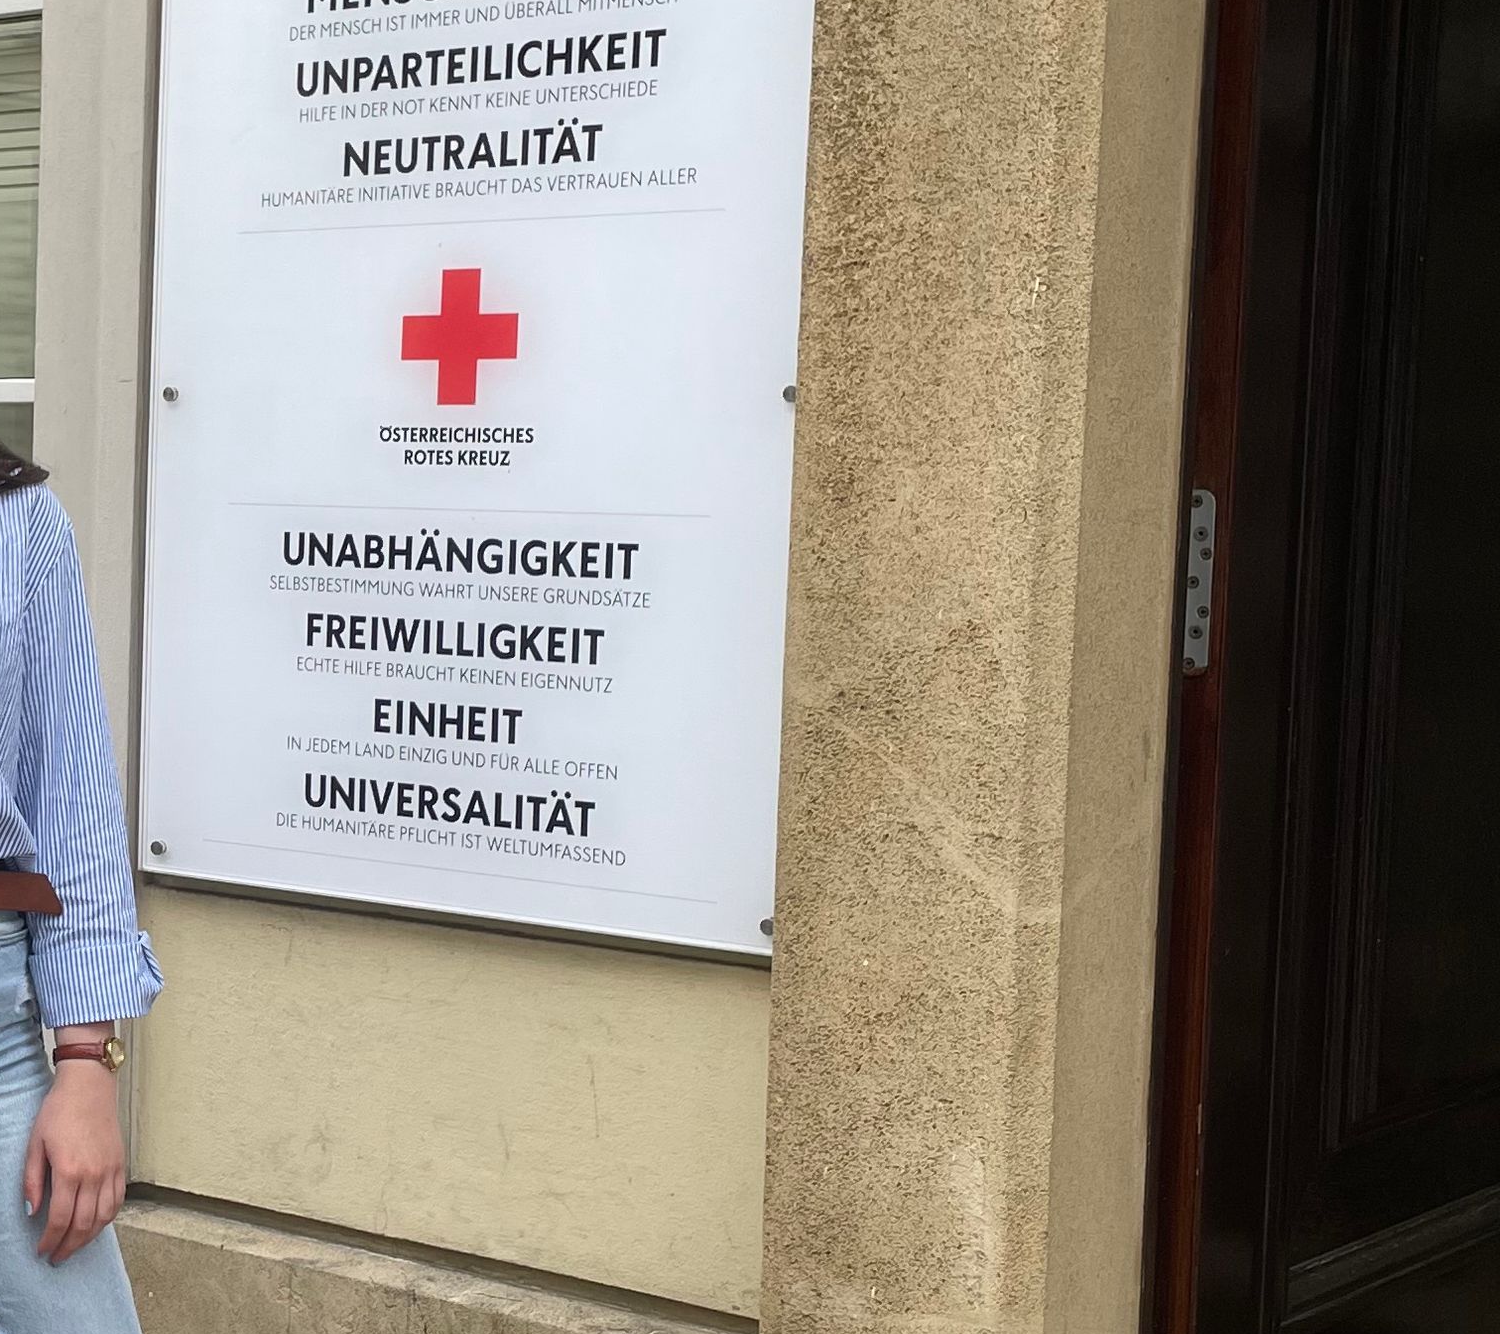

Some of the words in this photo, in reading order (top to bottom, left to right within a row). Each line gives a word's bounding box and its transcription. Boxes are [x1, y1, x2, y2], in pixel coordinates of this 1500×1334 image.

[289, 24, 317, 42] DER
[319, 17, 382, 39] MENSCH
[385, 11, 408, 33] IST
[410, 8, 461, 30] IMMER
[464, 5, 501, 25] UND
[296, 28, 668, 98] UNPARTEILICHKEIT
[299, 104, 338, 124] HILFE
[340, 101, 357, 120] IN
[360, 98, 389, 119] DER
[392, 97, 426, 117] NOT
[428, 93, 482, 114] KENNT
[485, 89, 532, 109] KEINE
[535, 78, 659, 106] UNTERSCHIEDE
[343, 117, 604, 178] NEUTRALITÄT
[261, 186, 355, 208] HUMANITÄRE
[358, 182, 431, 203] INITIATIVE
[435, 178, 508, 199] BRAUCHT
[511, 172, 543, 195] DAS
[546, 170, 643, 192] VERTRAUEN
[646, 167, 697, 187] ALLER
[379, 425, 534, 444] ÖSTERREICHISCHES
[404, 449, 454, 466] ROTES
[457, 449, 511, 467] KREUZ
[283, 529, 640, 581] UNABHÄNGIGKEIT
[269, 574, 415, 597] SELBSTBESTIMMUNG
[418, 581, 475, 600] WAHRT
[478, 584, 540, 604] UNSERE
[542, 587, 652, 609] GRUNDSÄTZE
[306, 612, 605, 666] FREIWILLIGKEIT
[296, 655, 341, 674] ECHTE
[343, 659, 383, 677] HILFE
[385, 662, 456, 683] BRAUCHT
[459, 666, 517, 687] KEINEN
[520, 671, 613, 694] EIGENNUTZ
[373, 698, 523, 745] EINHEIT
[287, 735, 302, 751] IN
[305, 737, 351, 756] JEDEM
[354, 741, 396, 760] LAND
[398, 744, 448, 766] EINZIG
[451, 745, 487, 769] UND
[490, 752, 520, 772] FÜR
[522, 756, 561, 776] ALLE
[564, 760, 618, 781] OFFEN
[304, 772, 596, 838] UNIVERSALITÄT
[276, 811, 299, 829] DIE
[301, 814, 396, 841] HUMANITÄRE
[399, 825, 458, 847] PFLICHT
[460, 832, 483, 851] IST
[485, 834, 626, 867] WELTUMFASSEND
